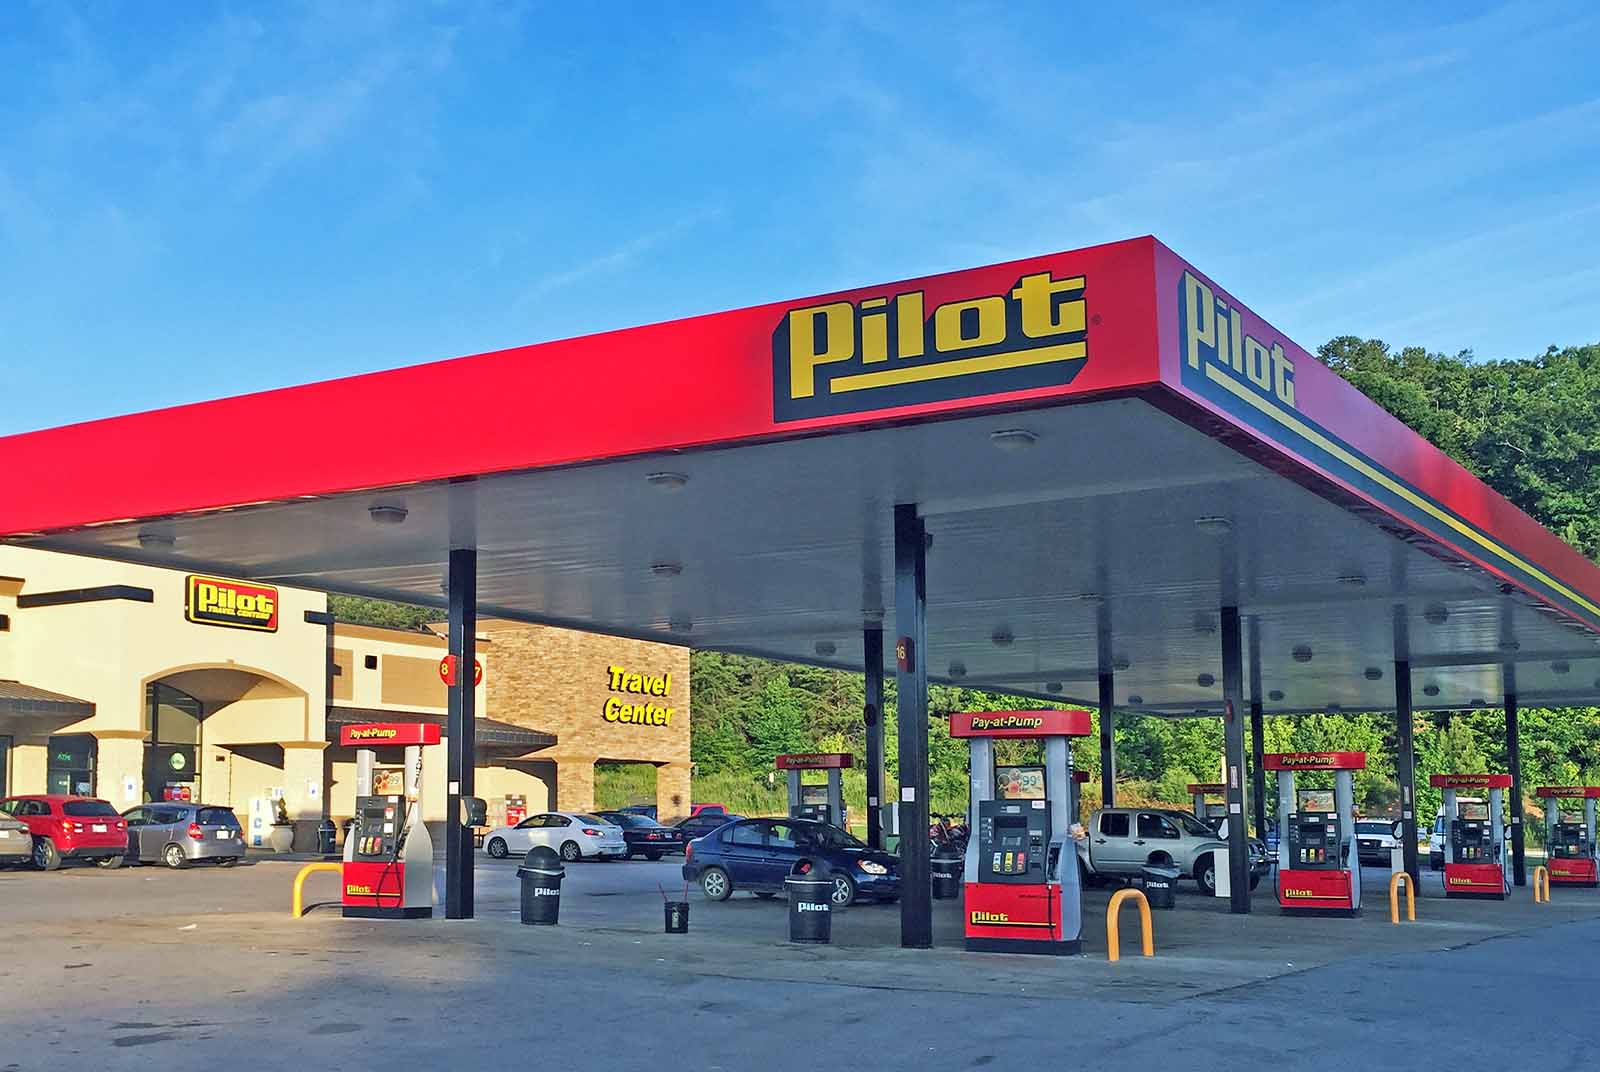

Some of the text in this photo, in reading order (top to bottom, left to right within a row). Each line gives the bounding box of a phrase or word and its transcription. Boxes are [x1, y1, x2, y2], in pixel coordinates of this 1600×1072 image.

[790, 272, 1087, 399] Pilot
[1185, 270, 1295, 409] Pilot
[198, 583, 274, 613] Pilot
[896, 645, 906, 659] 16
[441, 663, 449, 675] 8
[608, 665, 672, 697] Travel
[603, 697, 675, 726] Center
[972, 716, 1043, 729] Pay-at-Pump
[350, 728, 397, 739] Pay-at-Pump
[1281, 756, 1336, 766] Pay-at-Pump
[347, 884, 371, 895] Pilot
[797, 902, 829, 912] Pilot
[971, 911, 1008, 924] Pilot
